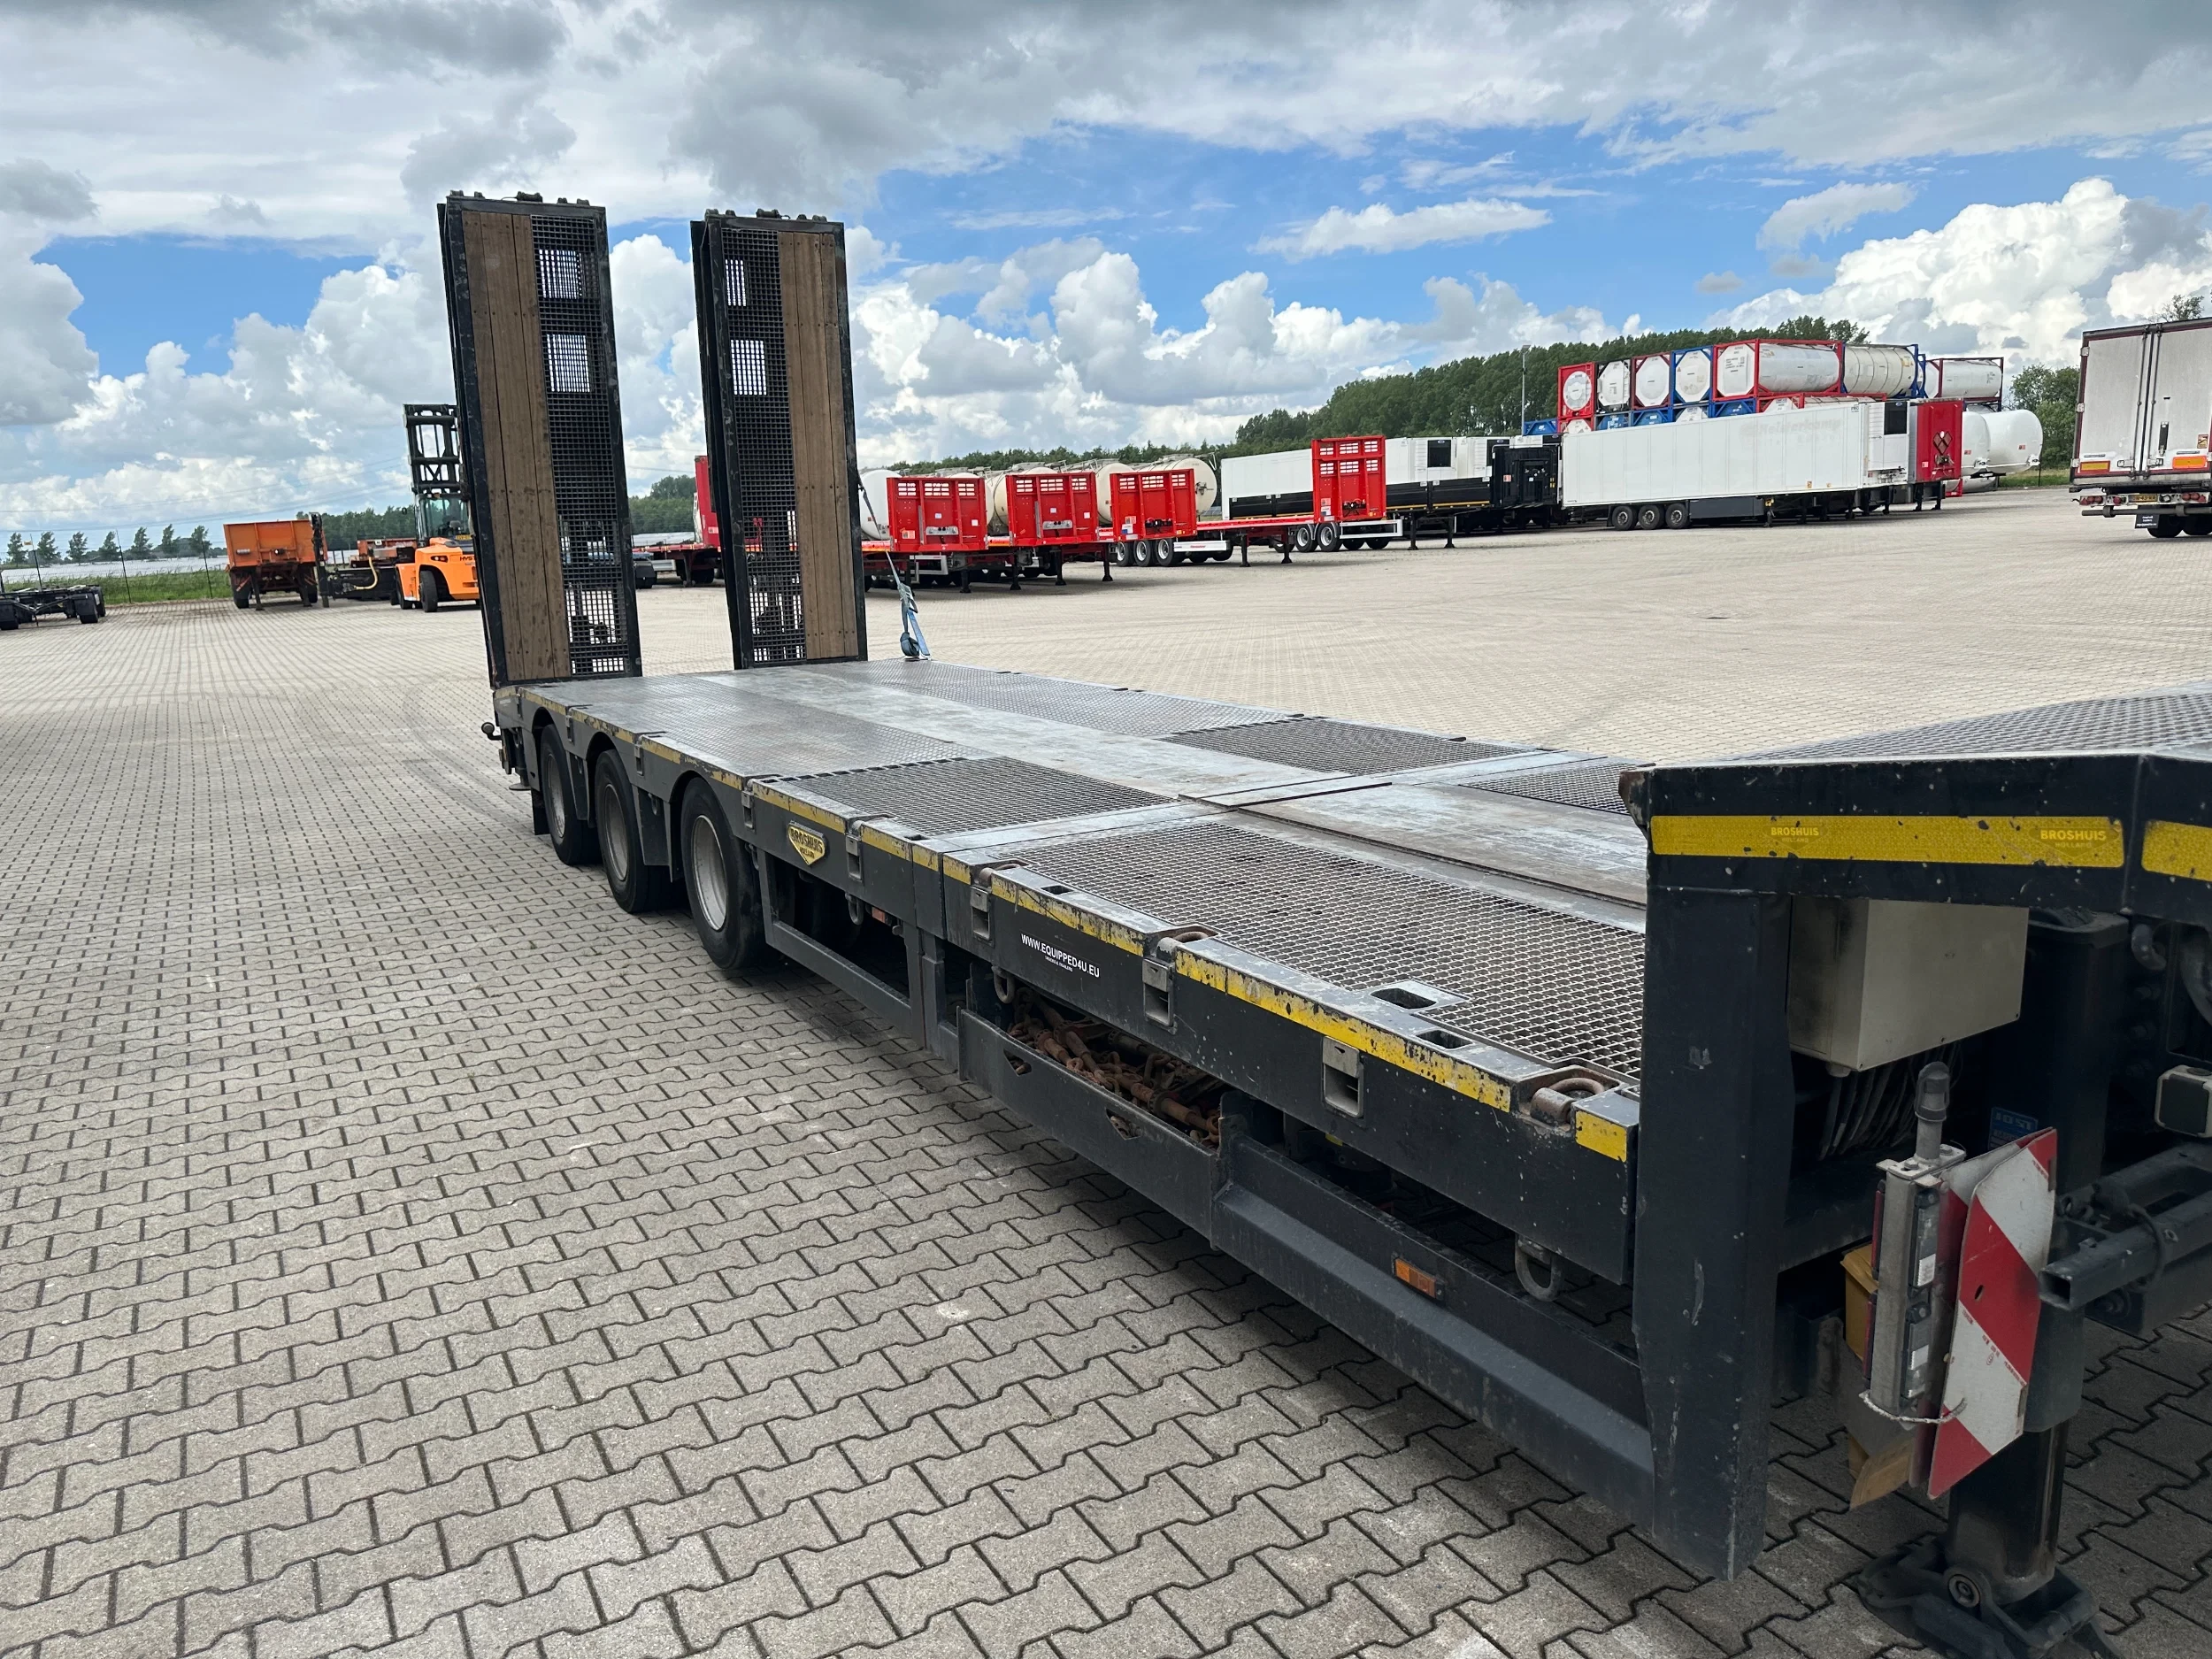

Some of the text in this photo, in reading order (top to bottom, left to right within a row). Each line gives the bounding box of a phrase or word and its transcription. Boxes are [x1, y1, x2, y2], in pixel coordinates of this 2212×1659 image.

[1770, 826, 1819, 836] BROSHUIS
[2039, 829, 2107, 841] BROSHUIS
[790, 827, 824, 855] BROSHUIS
[1020, 933, 1101, 979] WWW.EQUIPPED4U.EU
[1993, 1112, 2032, 1131] JOST
